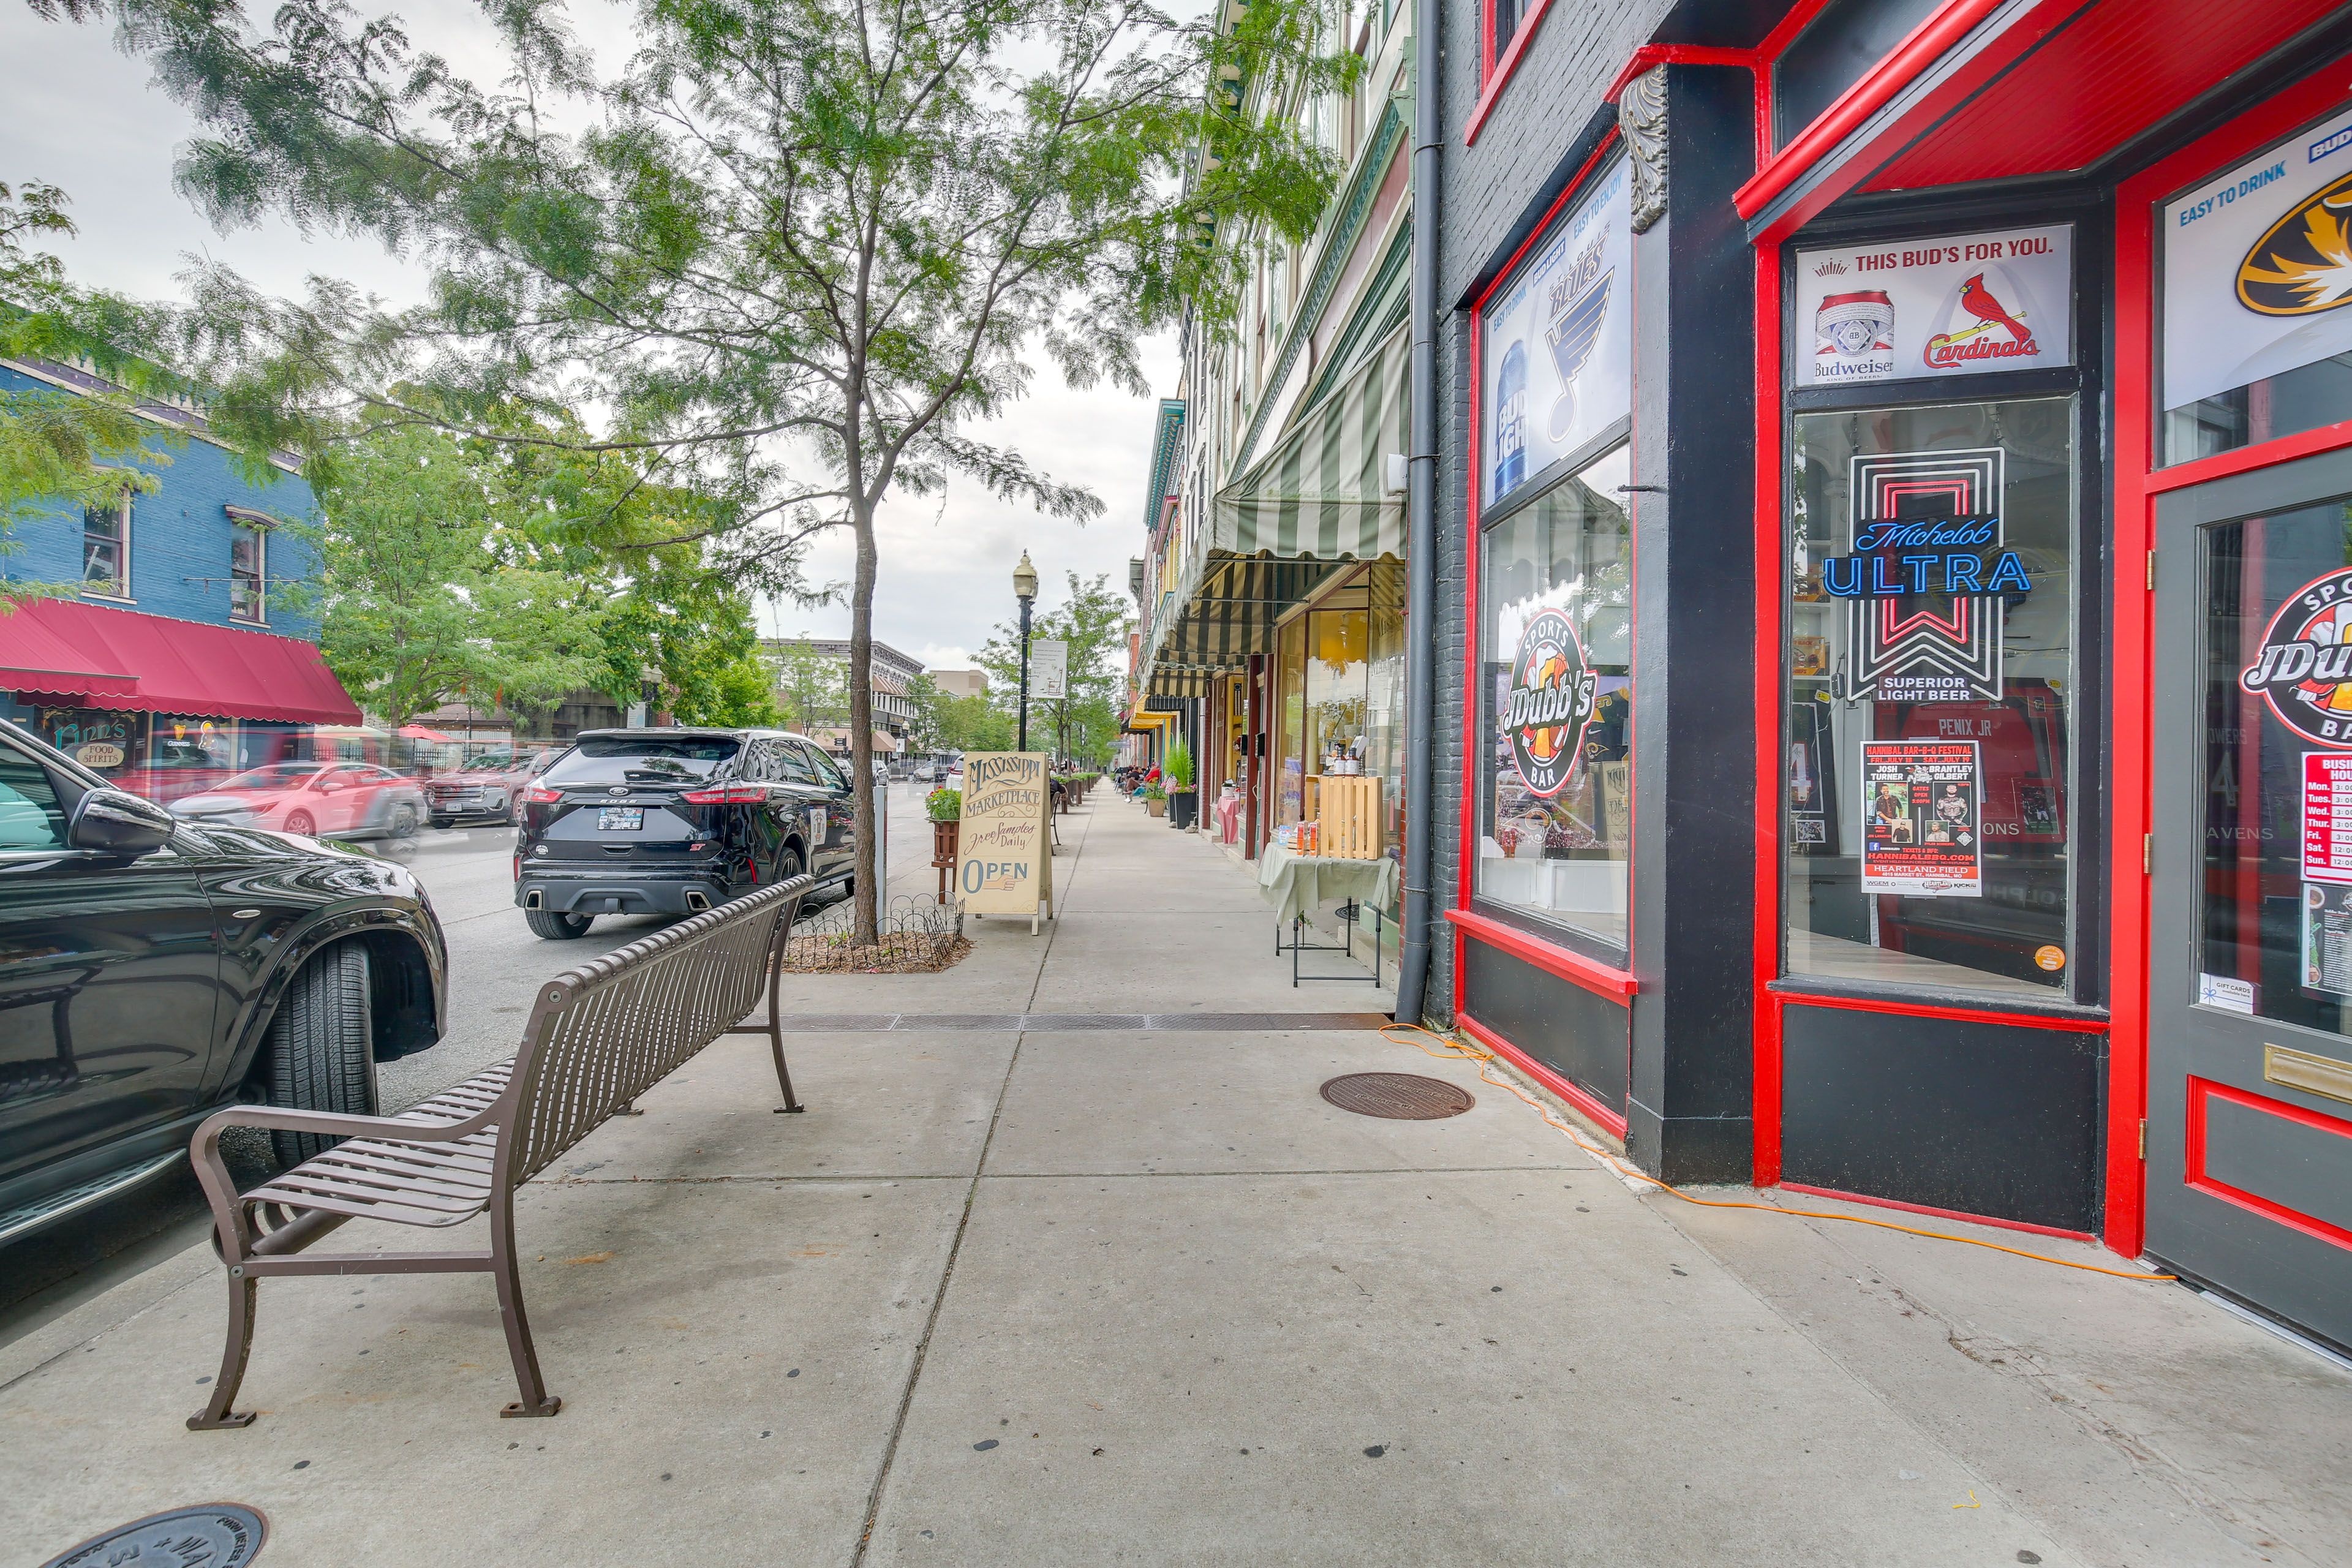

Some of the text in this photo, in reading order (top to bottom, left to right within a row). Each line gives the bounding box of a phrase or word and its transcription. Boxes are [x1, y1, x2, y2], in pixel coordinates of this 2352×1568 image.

[2311, 130, 2352, 159] BUD
[2180, 160, 2286, 227] EASY TO DRINK
[1574, 172, 1622, 239] EASY TO ENJOY
[1569, 220, 1611, 271] LOUIS
[1855, 237, 2053, 271] THIS BUD'S FOR YOU.
[1534, 241, 1565, 284] BUD LIGHT
[1548, 231, 1610, 323] BLUES
[1494, 284, 1527, 331] EASY TO DRINK
[1923, 334, 2041, 369] Cardinals
[1815, 360, 1893, 377] Budweiser
[1499, 390, 1527, 438] BUD
[1856, 518, 1999, 551] Michelob
[1823, 552, 2032, 596] ULTRA
[1525, 620, 1569, 655] SPORTS
[2246, 643, 2352, 685] JDu
[1884, 677, 1965, 688] SUPERIOR
[1504, 669, 1594, 731] JDubb's
[1879, 690, 1970, 701] LIGHT BEER
[1939, 718, 1992, 736] PENIX JR
[83, 754, 118, 763] SPIRITS
[89, 745, 113, 754] FOOD
[1866, 745, 1972, 755] HANNIBAL BAR-B-Q FESTIVAL
[968, 756, 1040, 799] MISSISSIPPI
[1531, 767, 1556, 786] BAR
[2211, 751, 2240, 807] 4
[2307, 782, 2330, 791] Mon.
[965, 790, 1040, 818] MARKETPLACE
[2307, 794, 2331, 803] Tues.
[2307, 807, 2330, 815] Wed.
[1982, 822, 2019, 835] ONS
[2307, 819, 2330, 827] Thur.
[963, 822, 1036, 856] Free Samples
[1000, 834, 1034, 851] Daily!
[2307, 831, 2321, 840] Fri.
[689, 843, 706, 851] ST
[2306, 843, 2324, 852] Sat.
[1868, 853, 1975, 861] HANNIBALBBQ.COM
[2306, 855, 2326, 864] Sun.
[962, 859, 1028, 894] OPEN
[2230, 985, 2250, 993] CARDS
[216, 1517, 243, 1532] FORD
